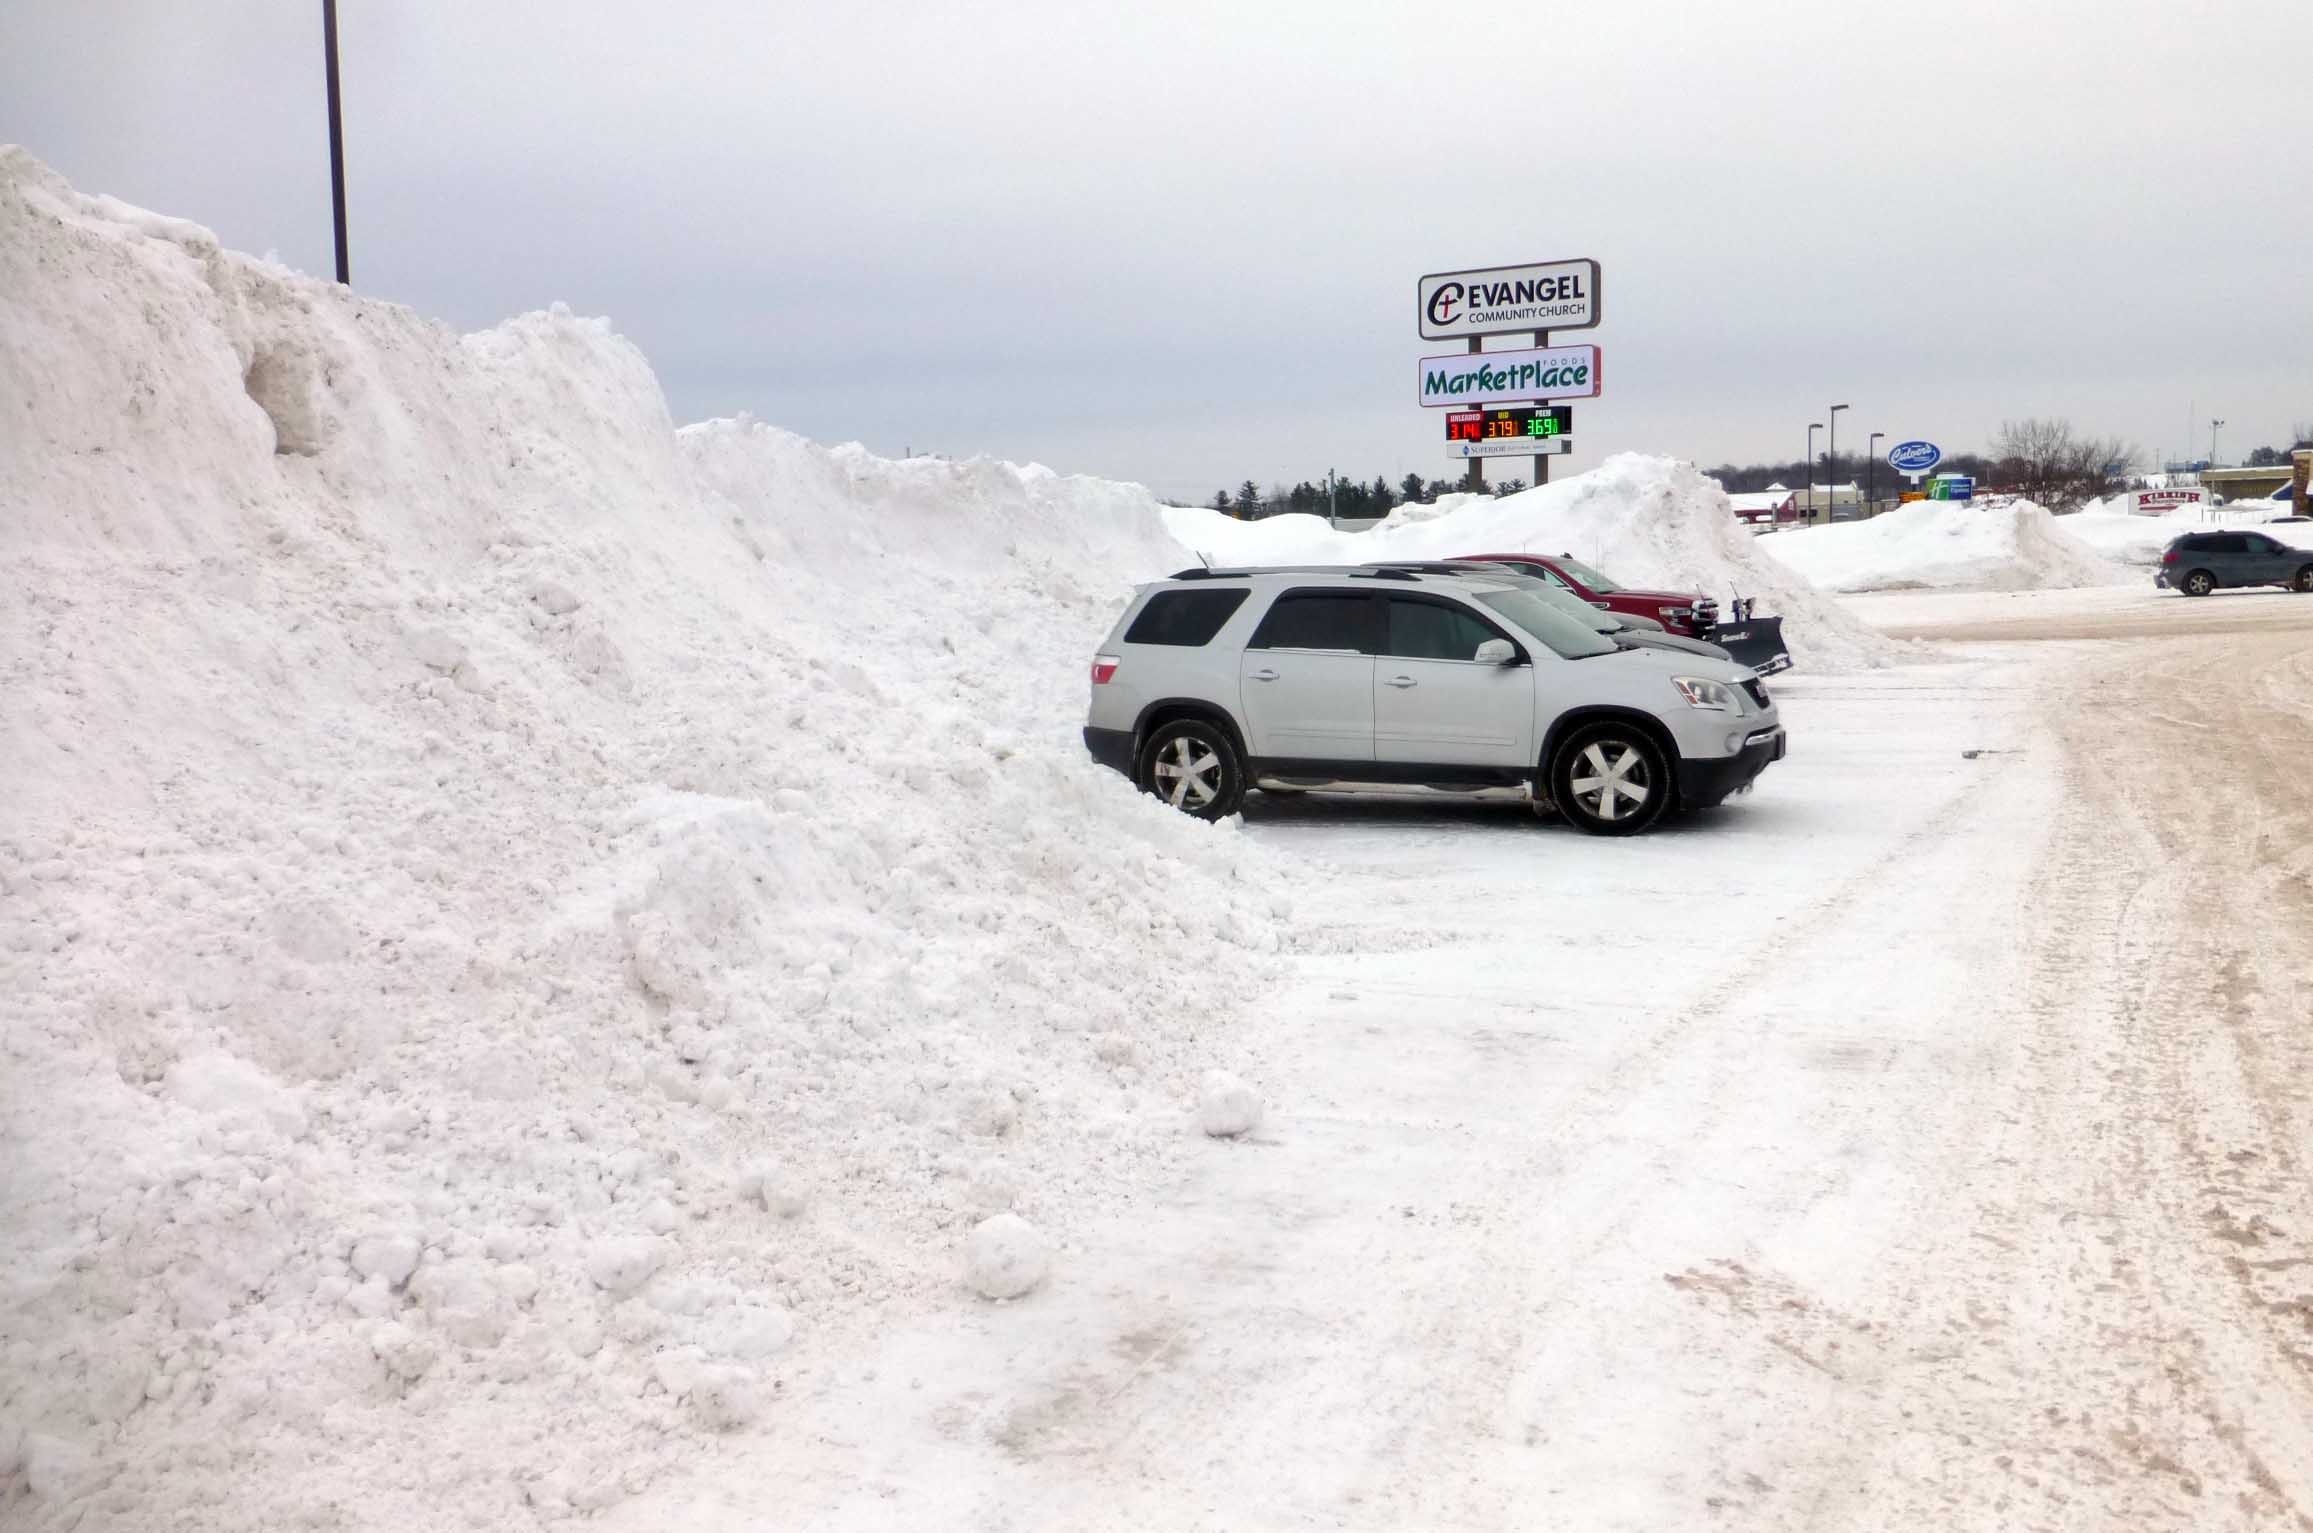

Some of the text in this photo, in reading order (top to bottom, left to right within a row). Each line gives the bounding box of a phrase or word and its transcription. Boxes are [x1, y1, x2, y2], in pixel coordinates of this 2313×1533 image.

[1468, 275, 1585, 309] EVANGEL
[1468, 303, 1585, 324] COMMUNITY CHURCH
[1543, 357, 1586, 367] FOODS
[1450, 413, 1481, 423] UNLEADED
